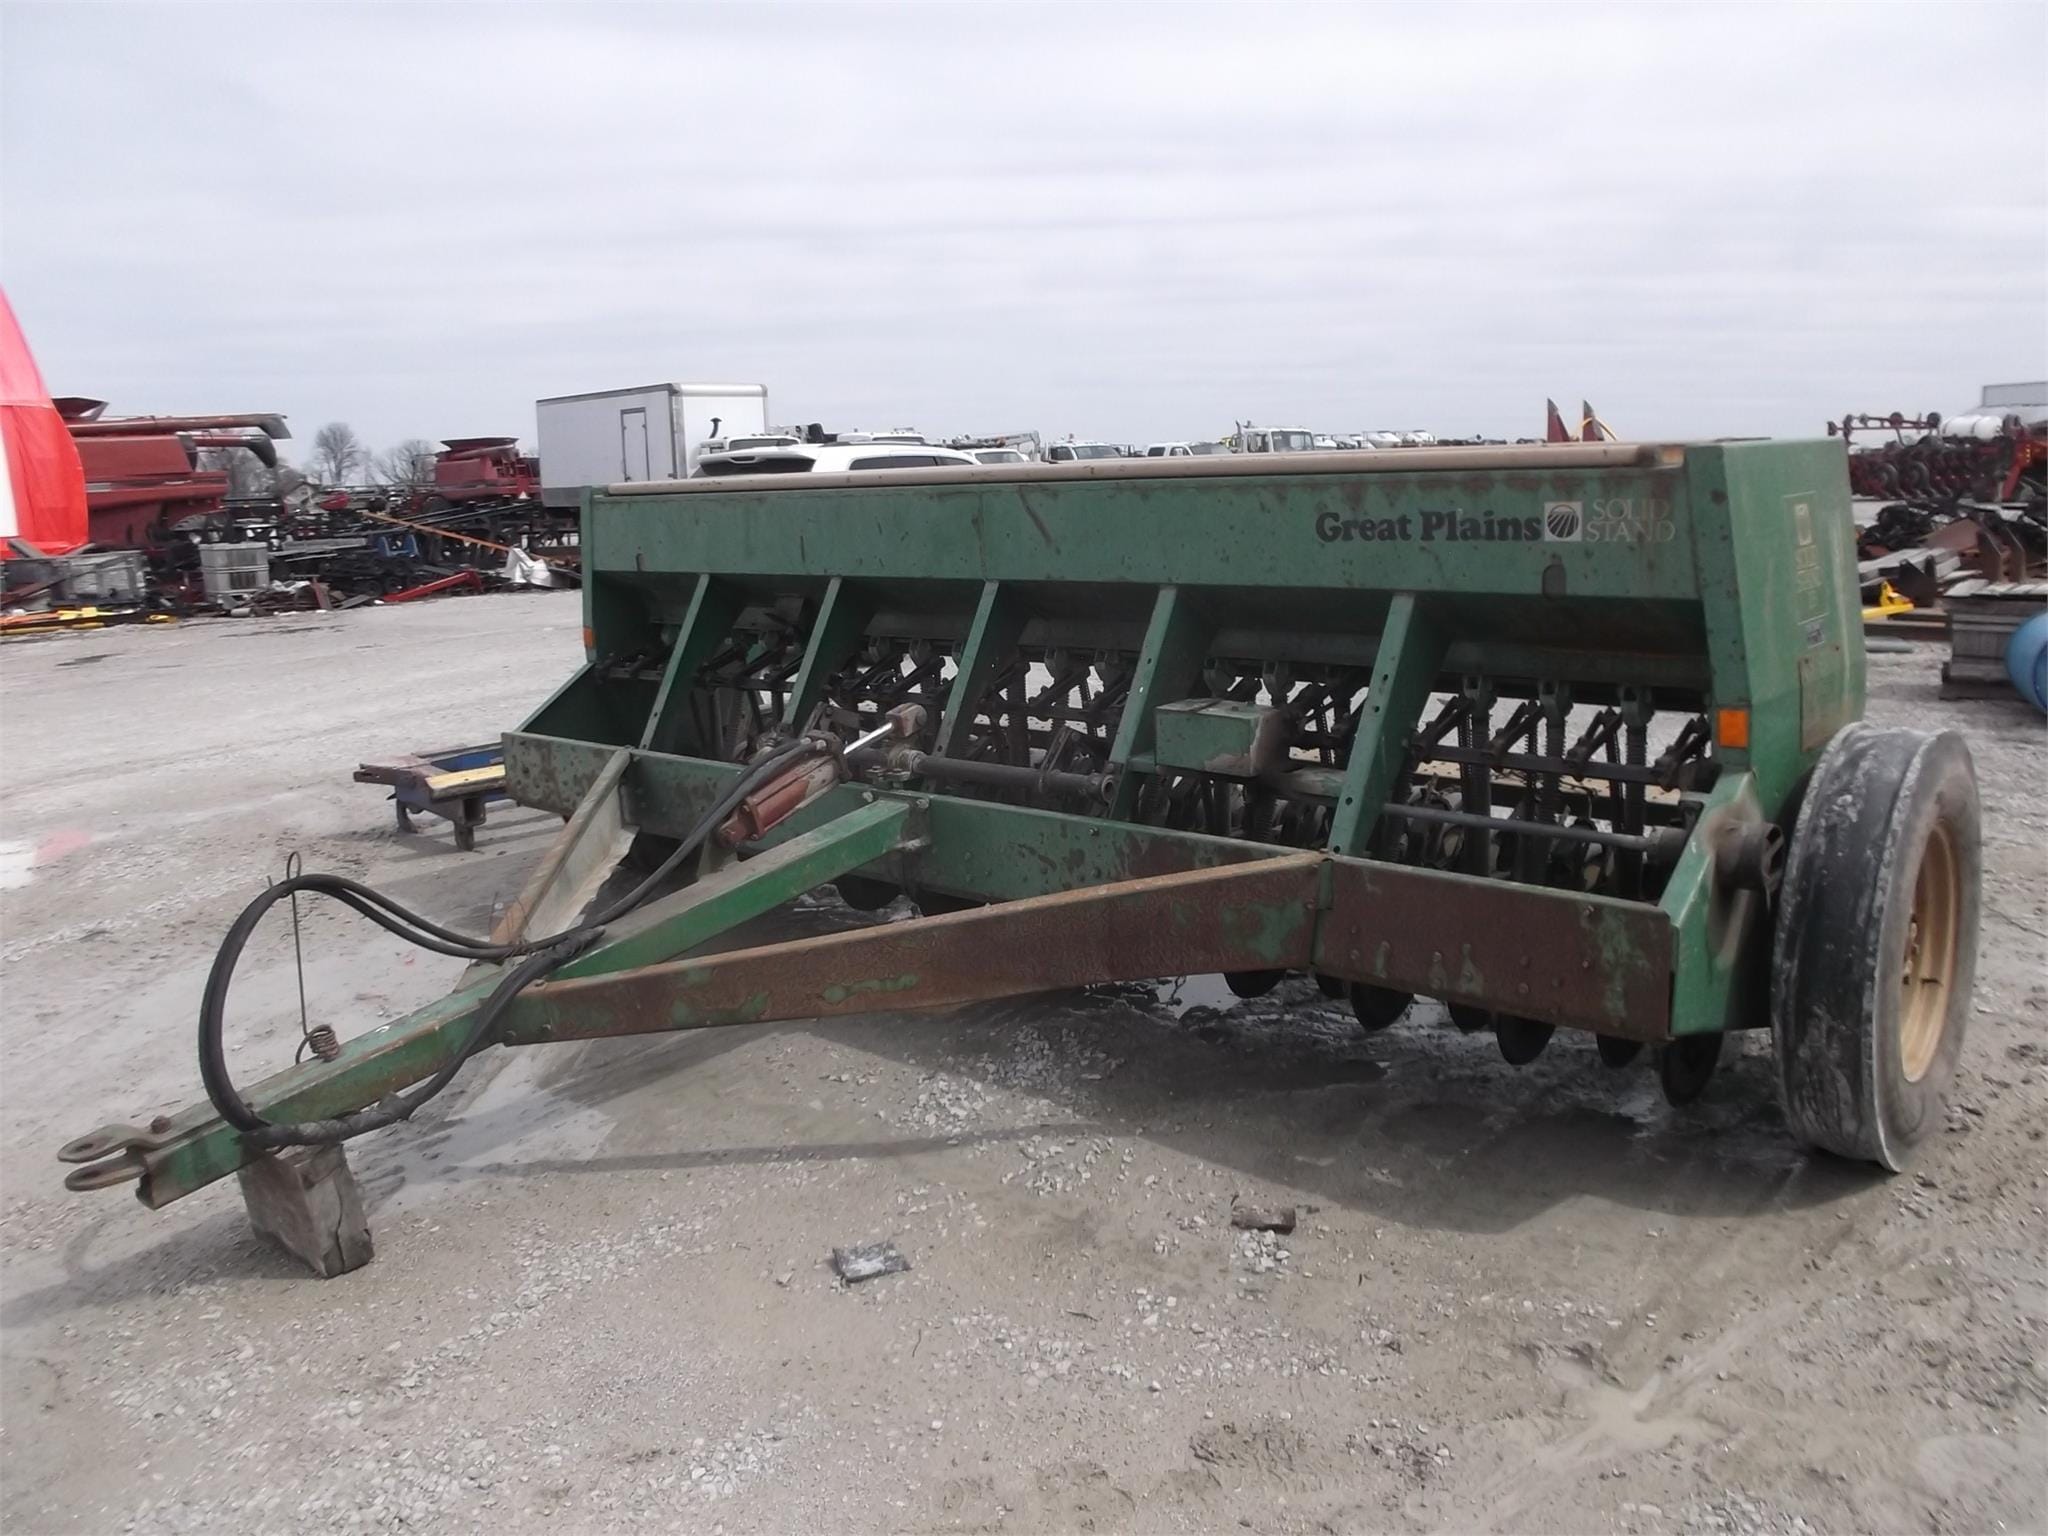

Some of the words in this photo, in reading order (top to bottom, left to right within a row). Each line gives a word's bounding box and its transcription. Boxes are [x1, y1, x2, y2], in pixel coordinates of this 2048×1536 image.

[1592, 498, 1669, 520] SOLID
[1315, 511, 1412, 542] Great
[1419, 509, 1542, 541] Plains
[1586, 519, 1677, 542] STAND
